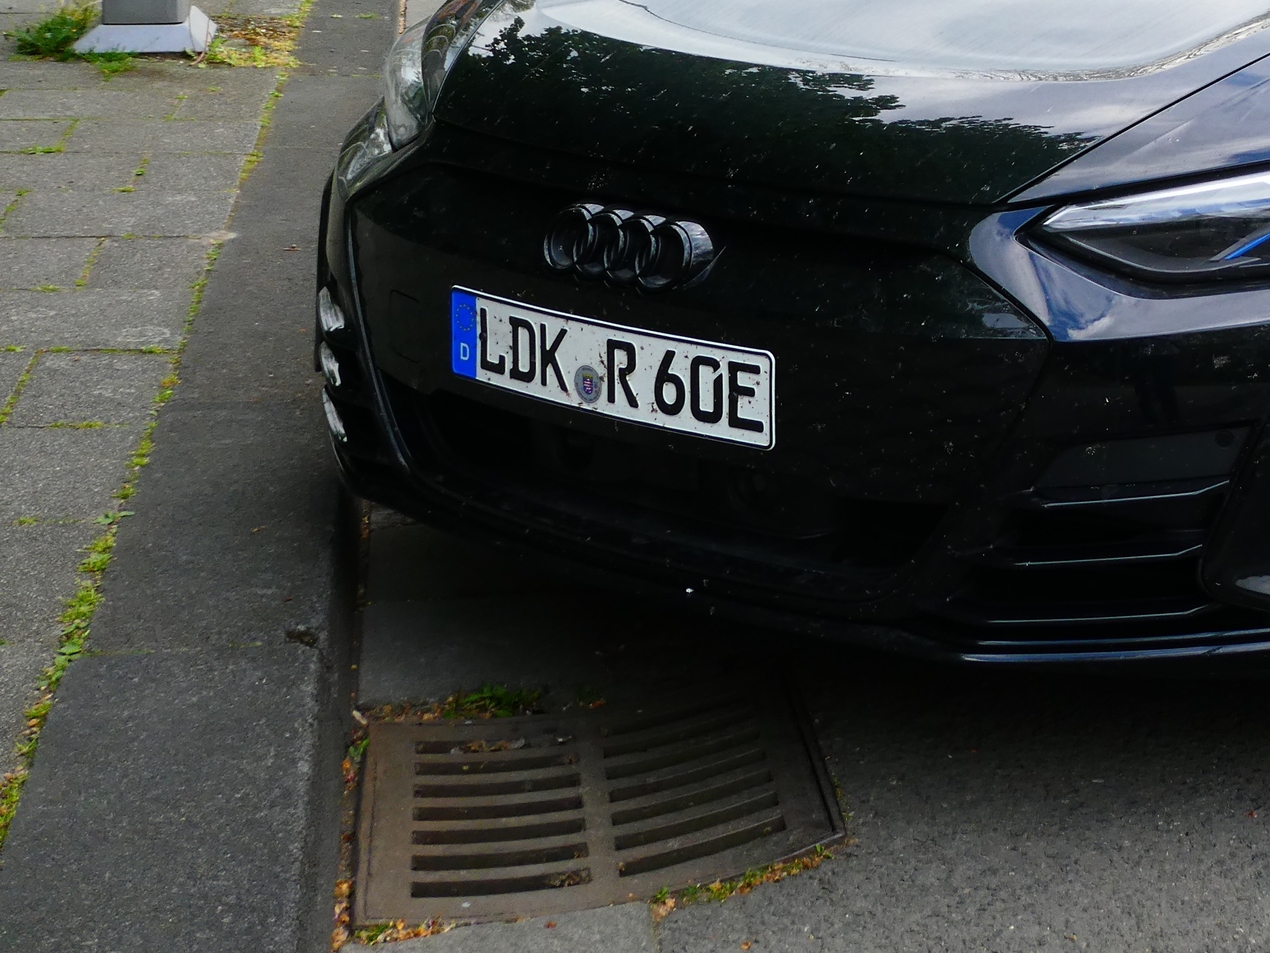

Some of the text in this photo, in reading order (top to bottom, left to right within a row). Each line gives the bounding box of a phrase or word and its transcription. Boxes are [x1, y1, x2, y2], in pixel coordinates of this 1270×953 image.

[460, 342, 470, 360] D
[480, 307, 569, 393] LDK
[607, 339, 639, 408] R
[655, 350, 764, 433] 60E
